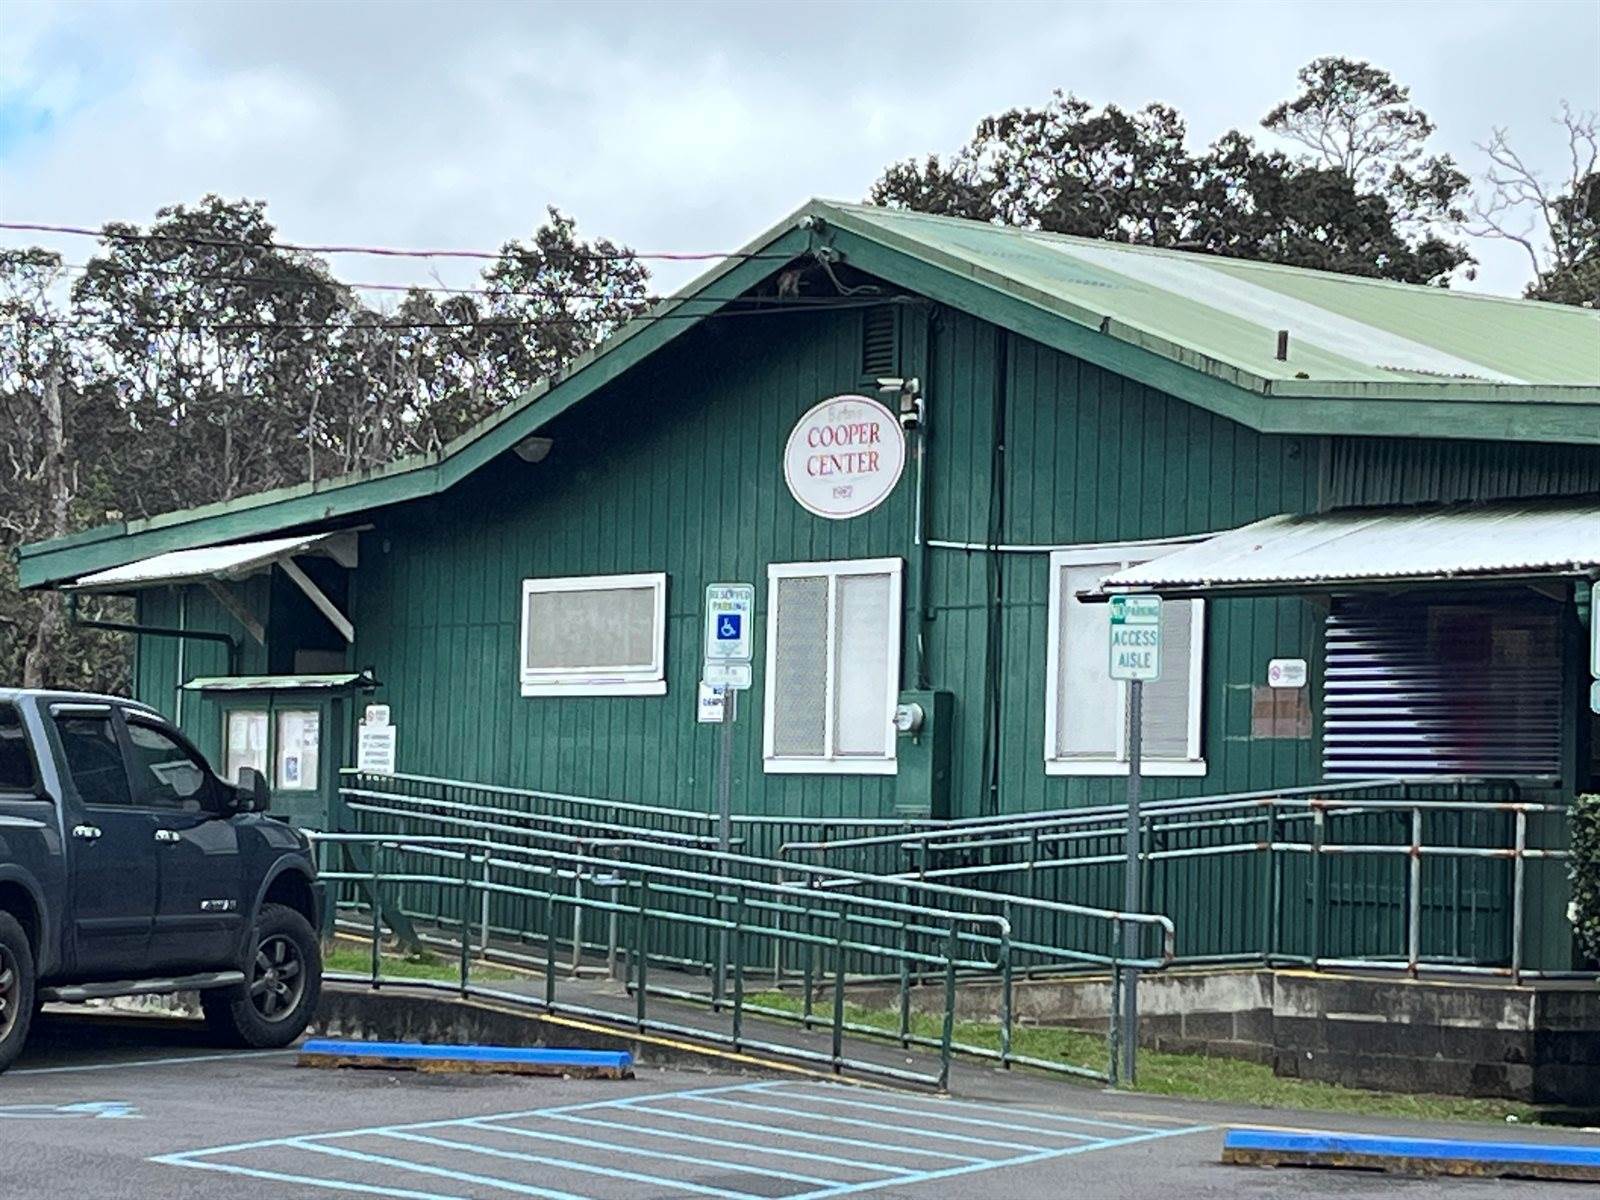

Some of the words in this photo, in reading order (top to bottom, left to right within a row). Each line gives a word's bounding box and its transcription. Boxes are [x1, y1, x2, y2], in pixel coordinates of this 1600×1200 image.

[807, 422, 881, 448] COOPER
[806, 450, 880, 477] CENTER
[1112, 629, 1158, 647] ACCESS
[1118, 651, 1151, 669] AISLE
